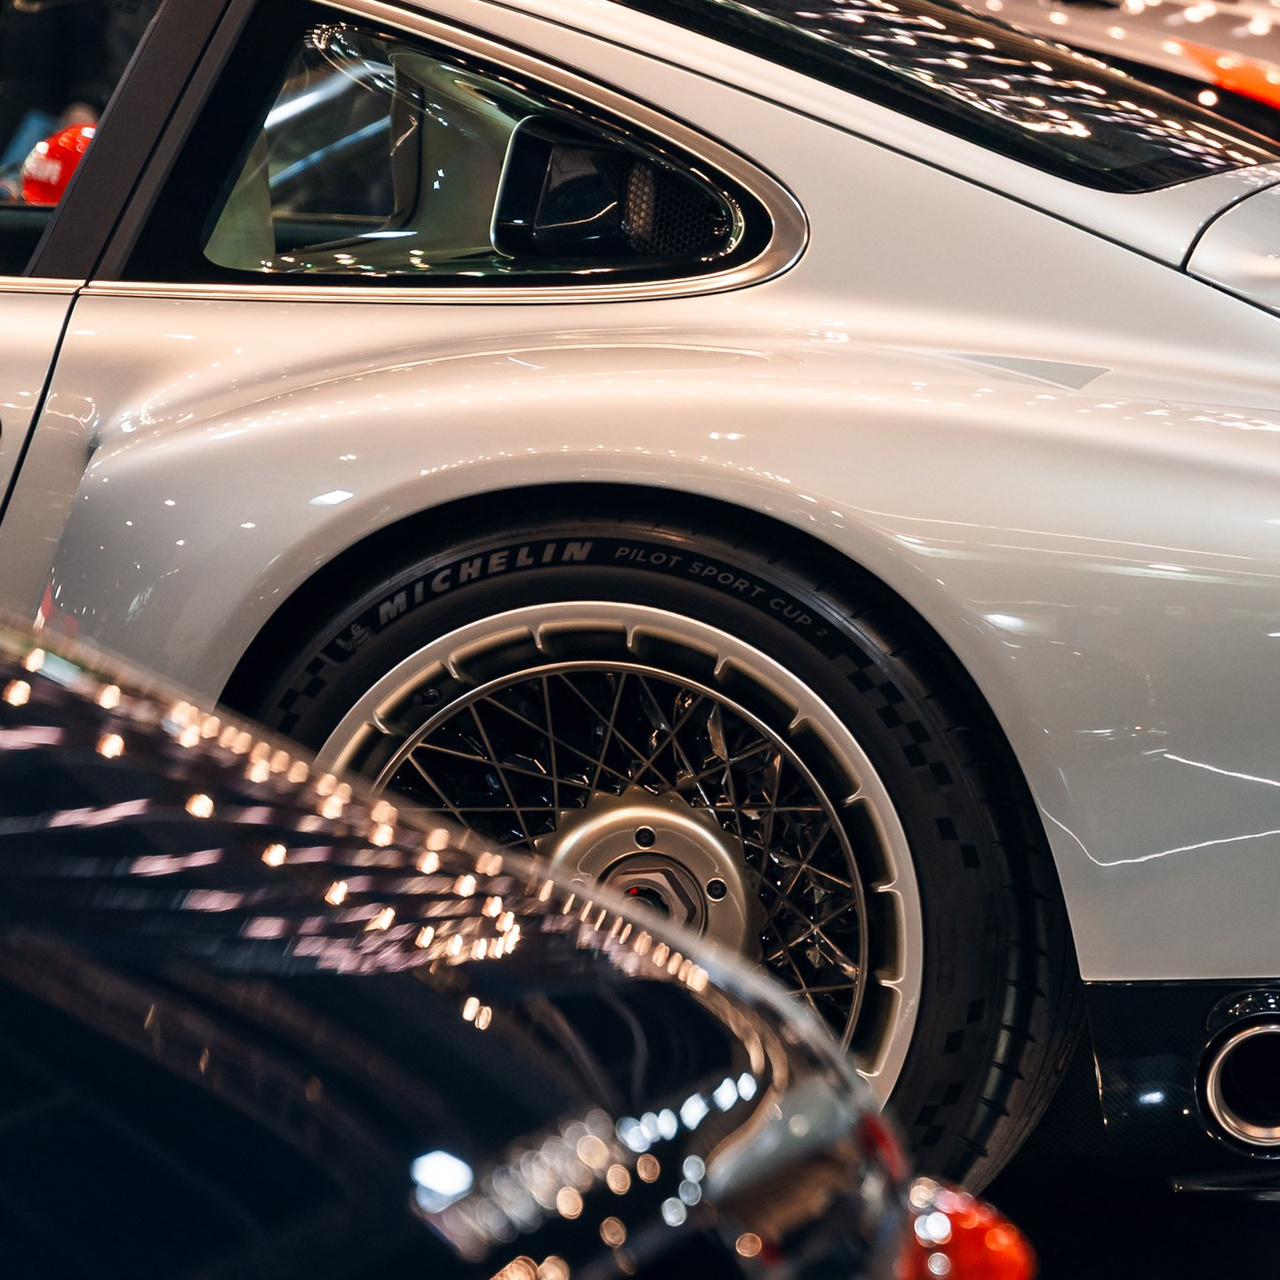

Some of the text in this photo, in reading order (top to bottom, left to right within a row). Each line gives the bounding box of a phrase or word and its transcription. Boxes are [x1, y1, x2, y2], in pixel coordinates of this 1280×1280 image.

[378, 541, 593, 626] MICHELIN
[614, 546, 829, 639] PILOT SPORT CUP 2
